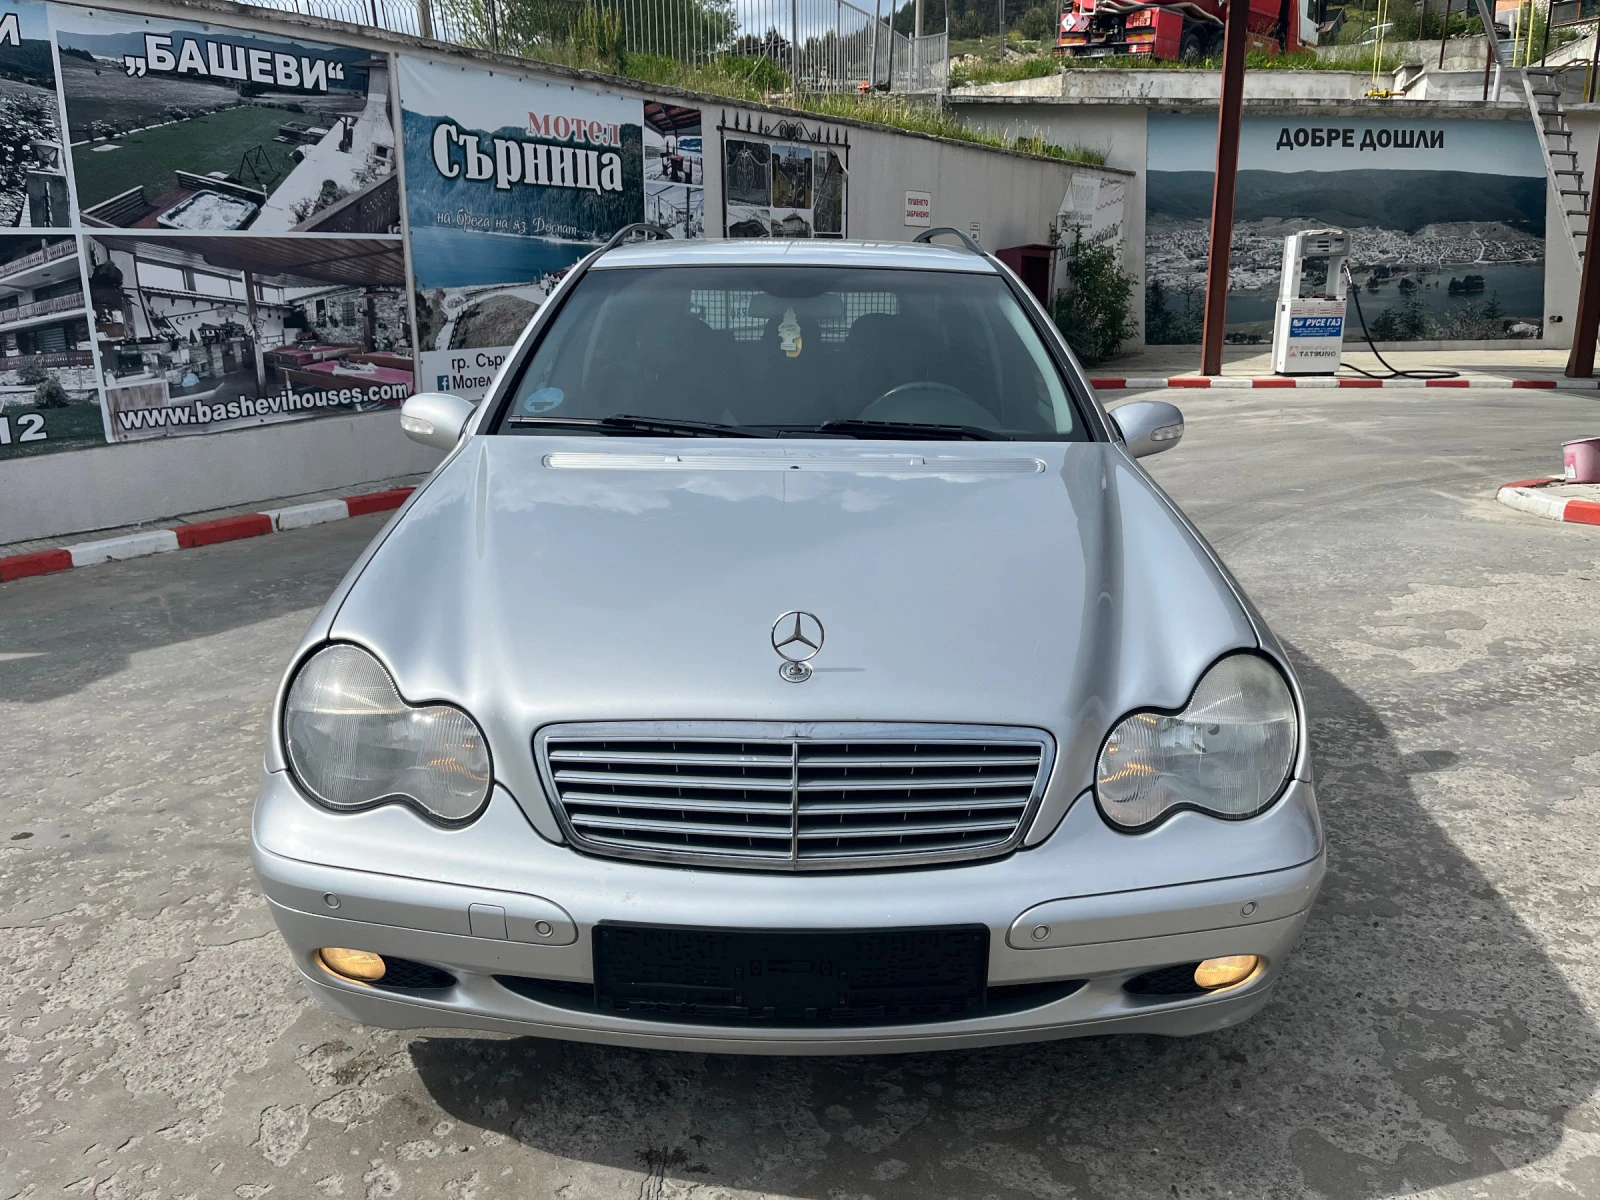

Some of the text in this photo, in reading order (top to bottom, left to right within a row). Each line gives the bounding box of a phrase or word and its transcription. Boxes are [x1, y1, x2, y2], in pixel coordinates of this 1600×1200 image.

[1276, 127, 1444, 152] ДОБРЕ ДОШЛИ
[433, 123, 624, 195] Сърница
[436, 210, 452, 225] на
[455, 208, 491, 233] брега
[494, 219, 509, 230] на
[532, 216, 578, 236] Доспат
[1305, 318, 1327, 328] РУСЕ
[1327, 318, 1341, 326] ГАЗ
[1299, 350, 1337, 358] TATSUNO
[451, 357, 470, 373] гр.
[452, 374, 492, 390] Мотел
[118, 382, 409, 431] www.bashevihouses.com
